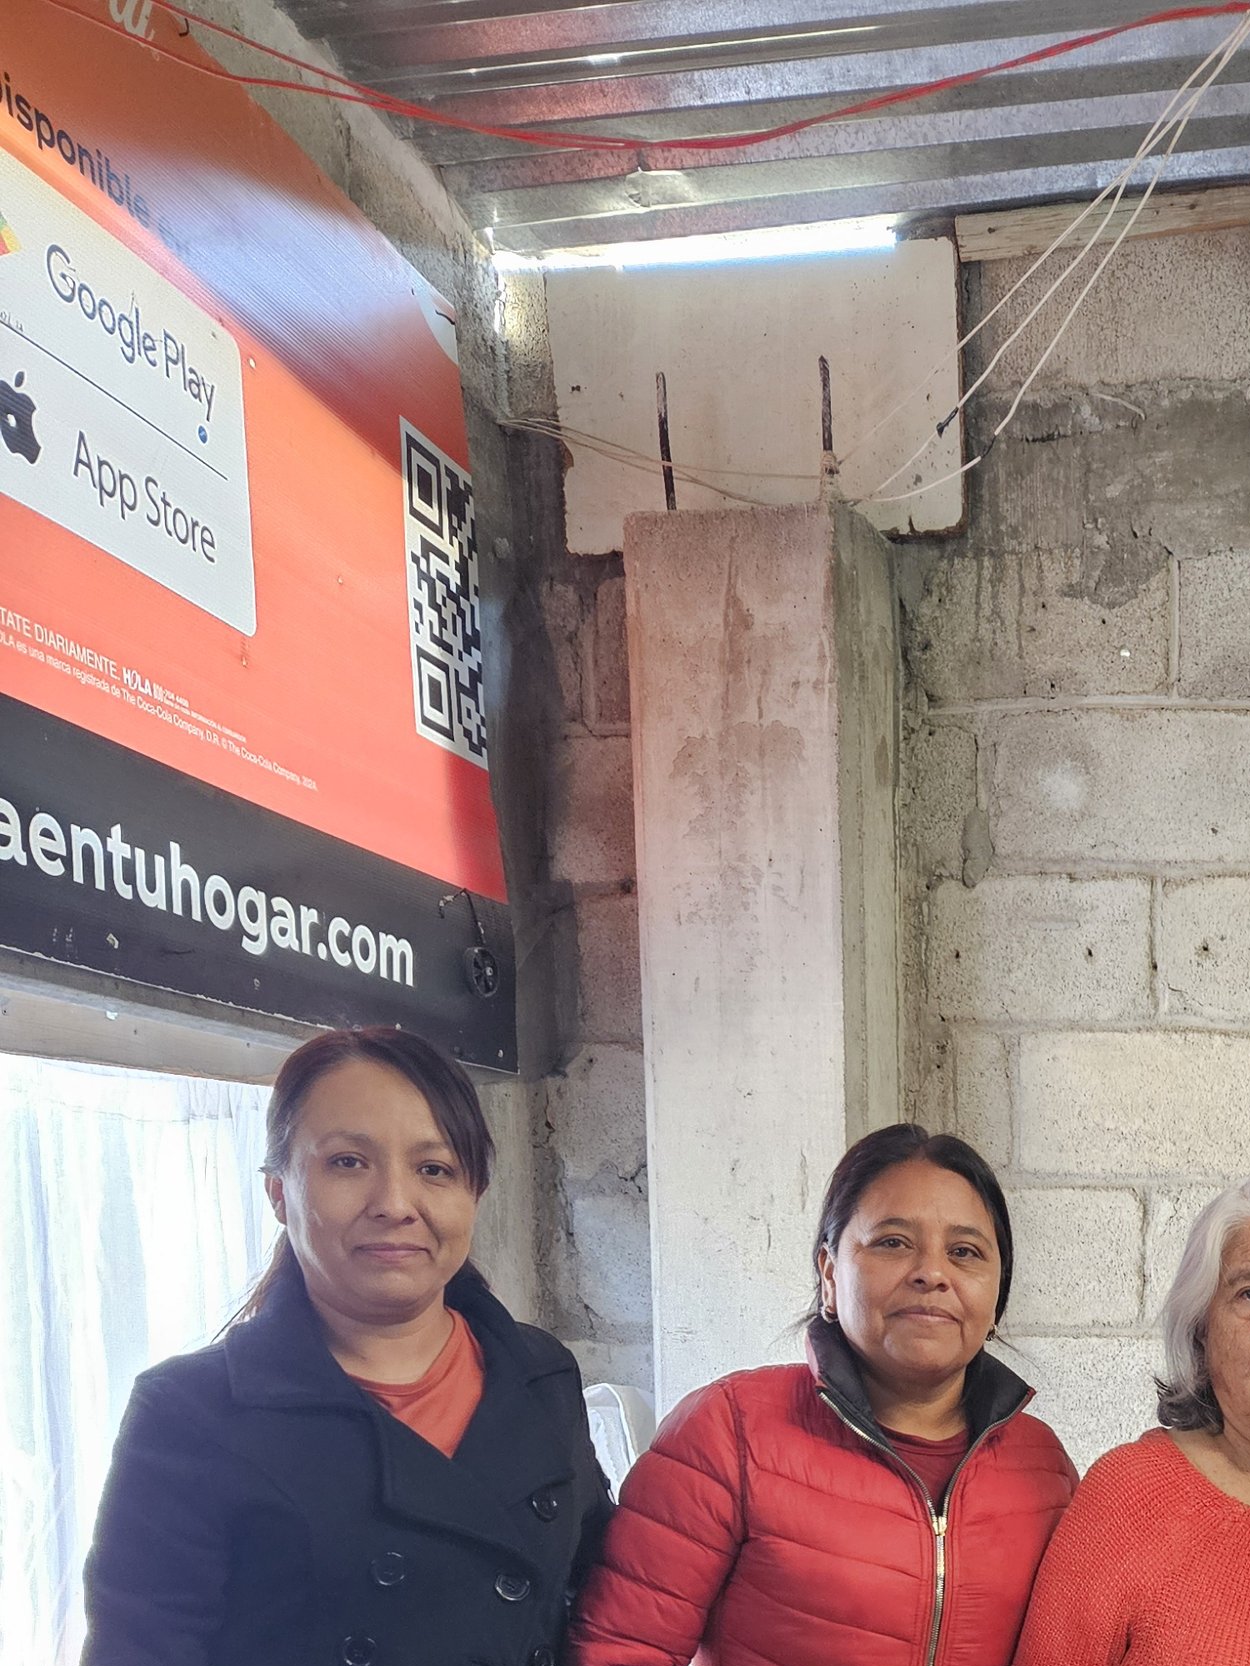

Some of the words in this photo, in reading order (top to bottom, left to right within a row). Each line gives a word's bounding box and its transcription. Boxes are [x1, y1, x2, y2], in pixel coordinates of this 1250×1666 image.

[0, 71, 150, 228] isponible
[47, 244, 157, 368] Google
[163, 329, 214, 421] Play
[73, 430, 137, 521] App
[144, 475, 216, 564] Store
[34, 623, 121, 681] DIARIAMENTE.
[0, 797, 414, 986] aentuhogar.com
